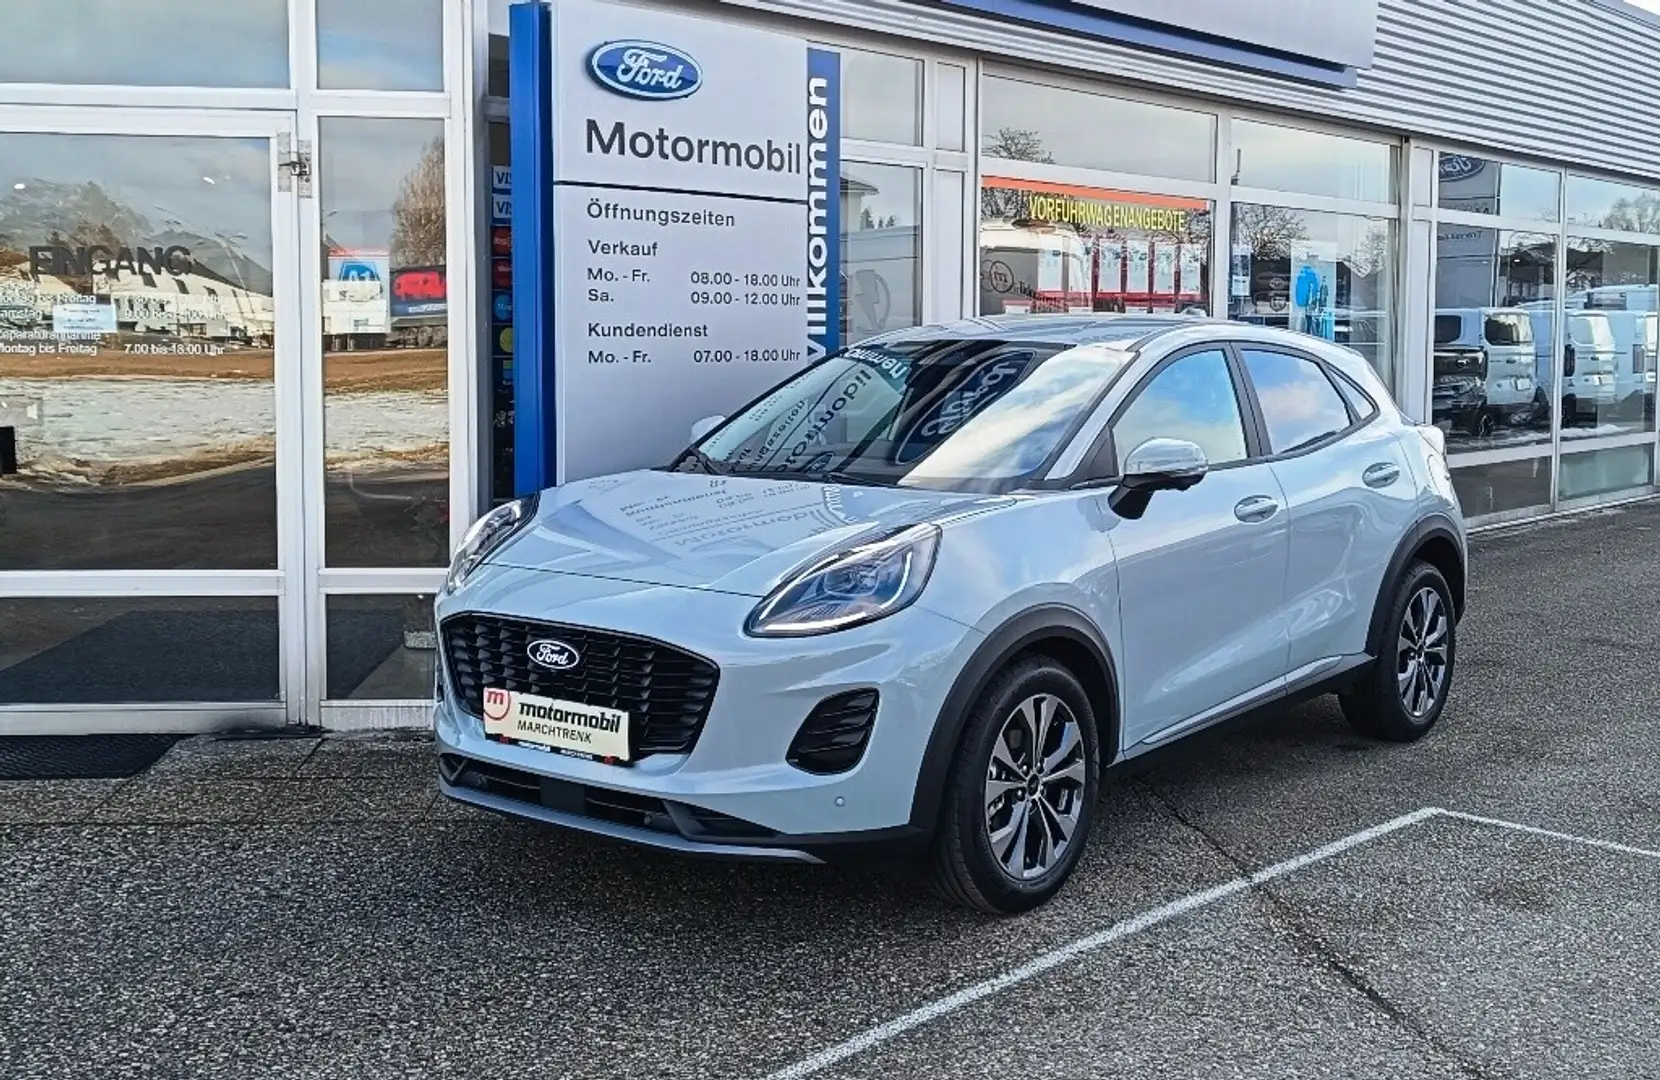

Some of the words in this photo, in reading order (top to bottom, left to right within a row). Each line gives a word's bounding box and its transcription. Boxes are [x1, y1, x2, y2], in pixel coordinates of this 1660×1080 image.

[616, 49, 683, 89] Ford
[586, 118, 801, 174] Motormobil
[587, 198, 735, 227] Öffnungszeiten
[587, 239, 658, 257] Verkauf
[29, 246, 191, 276] EINGANG
[587, 268, 619, 283] Mo.
[632, 269, 650, 282] Fr.
[690, 271, 732, 286] 08.00
[744, 273, 778, 287] 18.00
[781, 274, 800, 288] Uhr
[588, 288, 614, 302] Sa.
[690, 292, 732, 305] 09.00
[744, 293, 778, 305] 12.00
[781, 293, 800, 306] Uhr
[588, 323, 708, 338] Kundendienst
[39, 342, 55, 353] bis
[58, 343, 97, 356] Freitag
[124, 343, 149, 355] 7.00
[204, 343, 225, 356] Uhr
[588, 351, 619, 364] Mo.
[632, 351, 651, 363] Fr.
[693, 350, 732, 363] 07.00
[744, 350, 778, 362] 18.00
[781, 350, 800, 362] Uhr
[536, 643, 569, 665] Ford
[487, 691, 504, 705] m
[518, 701, 621, 733] motormobil
[517, 720, 592, 744] MARCHTRENK
